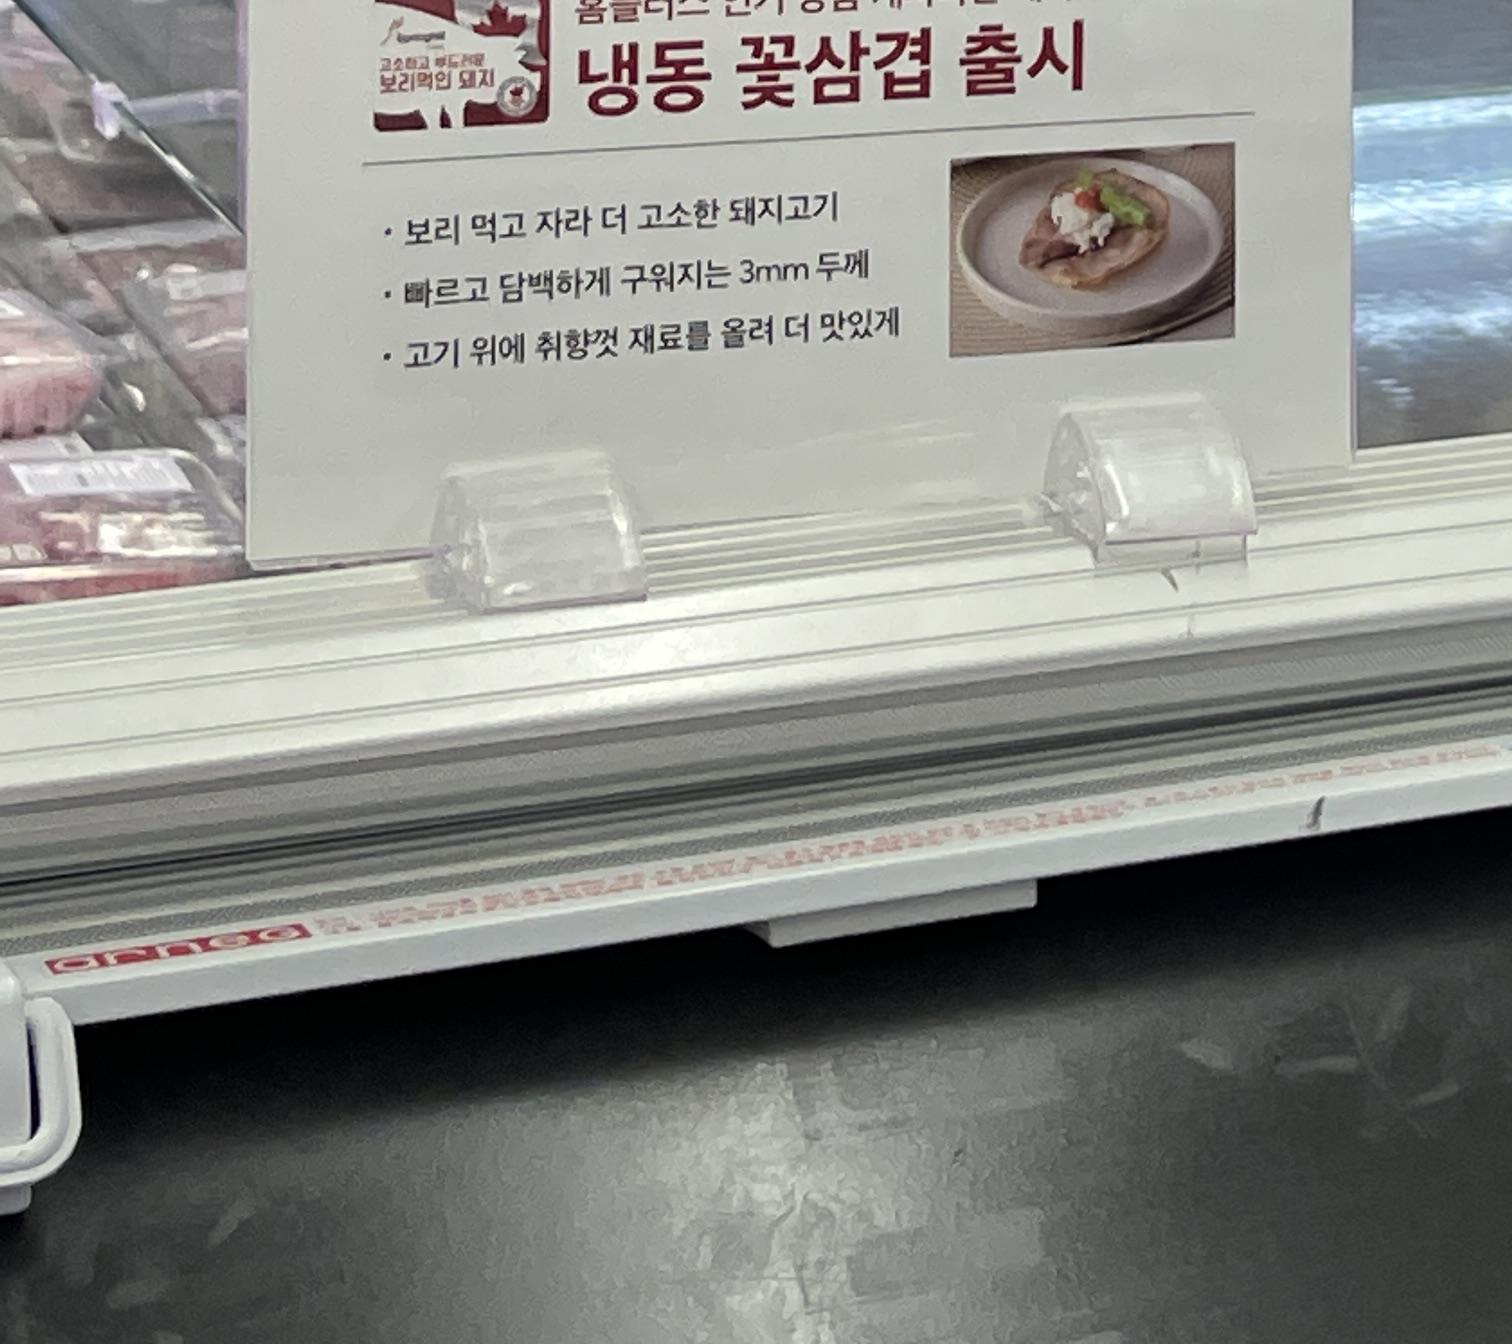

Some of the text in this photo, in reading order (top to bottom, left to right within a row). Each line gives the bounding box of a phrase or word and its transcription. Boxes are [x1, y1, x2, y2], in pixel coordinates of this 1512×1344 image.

[577, 18, 1085, 117] 냉동 꽃삼겹 출시
[404, 191, 839, 246] 보리 먹고 자라 더 고소한 돼지고기
[499, 266, 611, 304] 담백하게
[620, 259, 733, 296] 구워지는
[738, 257, 809, 283] 3mm
[815, 249, 870, 282] 두께
[403, 307, 902, 369] 고기 위에 취향껏 재료를 올려 더 맛있게
